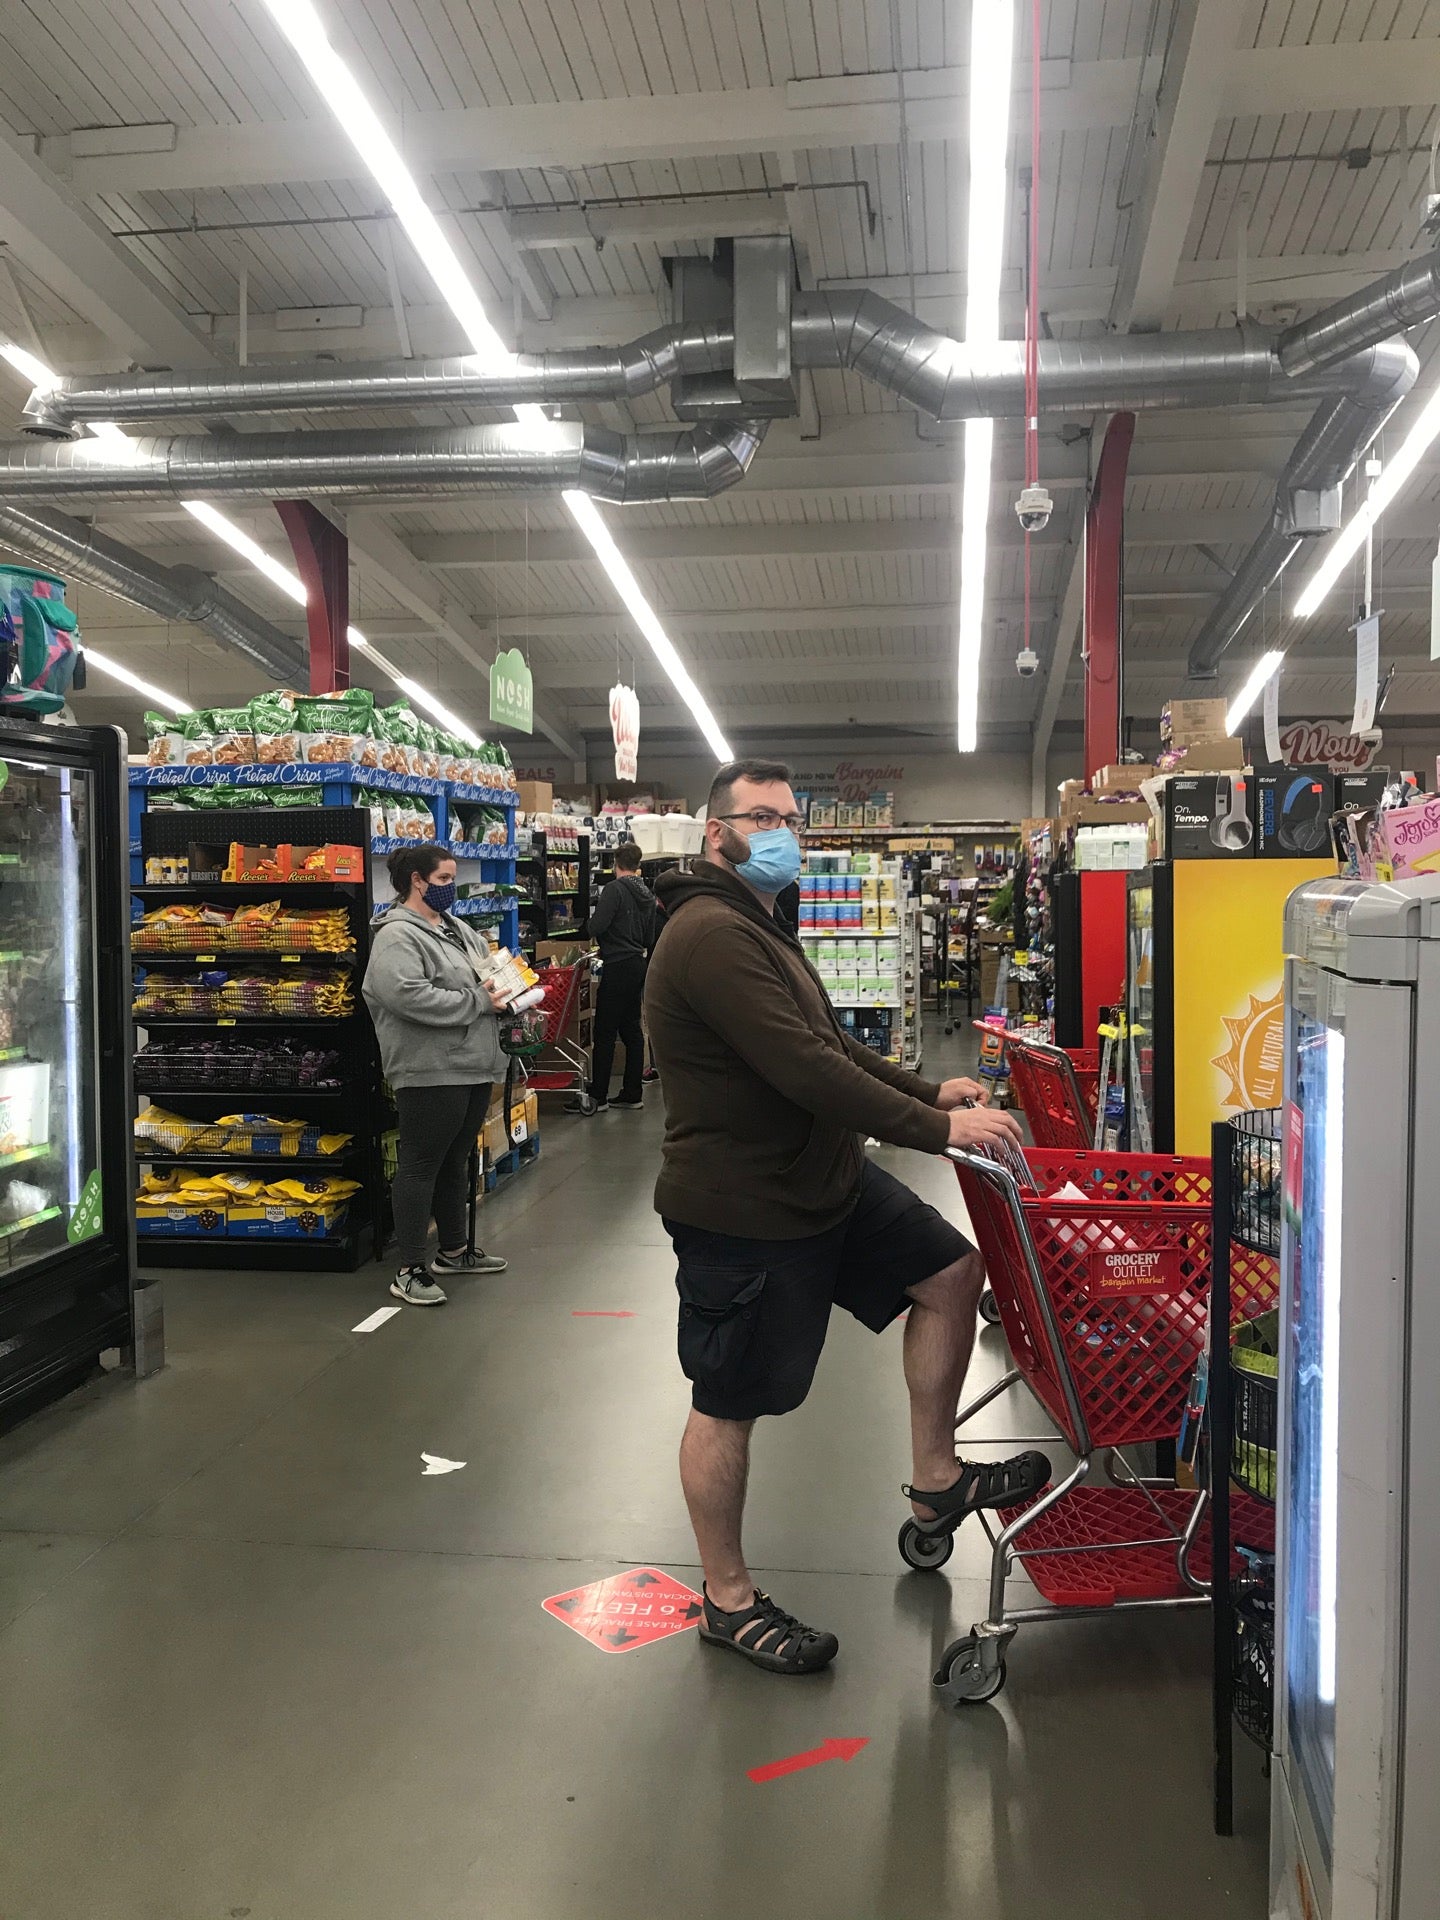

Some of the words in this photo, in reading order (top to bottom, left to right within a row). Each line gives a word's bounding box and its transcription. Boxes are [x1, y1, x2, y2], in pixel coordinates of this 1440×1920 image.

[496, 674, 530, 711] NOSH
[145, 765, 190, 786] Pretzel
[190, 765, 231, 785] Crisps
[233, 764, 281, 785] Pretzel
[280, 764, 322, 784] Crisps
[351, 765, 372, 785] Pretzel
[515, 767, 556, 780] EALS
[836, 761, 904, 785] Bargains
[1174, 805, 1191, 814] On.
[1264, 789, 1275, 836] REVERB
[1174, 815, 1210, 824] Tempo.
[191, 871, 219, 881] HERSHEY'S
[240, 871, 269, 881] Reese's
[288, 871, 317, 881] Reese's
[1252, 1077, 1275, 1100] ALL
[73, 1182, 99, 1235] NOSH
[1105, 1252, 1160, 1267] GROCERY
[1113, 1264, 1152, 1278] OUTLET
[1100, 1275, 1135, 1290] bargain
[1136, 1275, 1167, 1285] market
[657, 1593, 699, 1602] SOCIAL
[593, 1602, 653, 1616] FEET
[660, 1604, 675, 1616] 6
[636, 1621, 683, 1630] PLEASE
